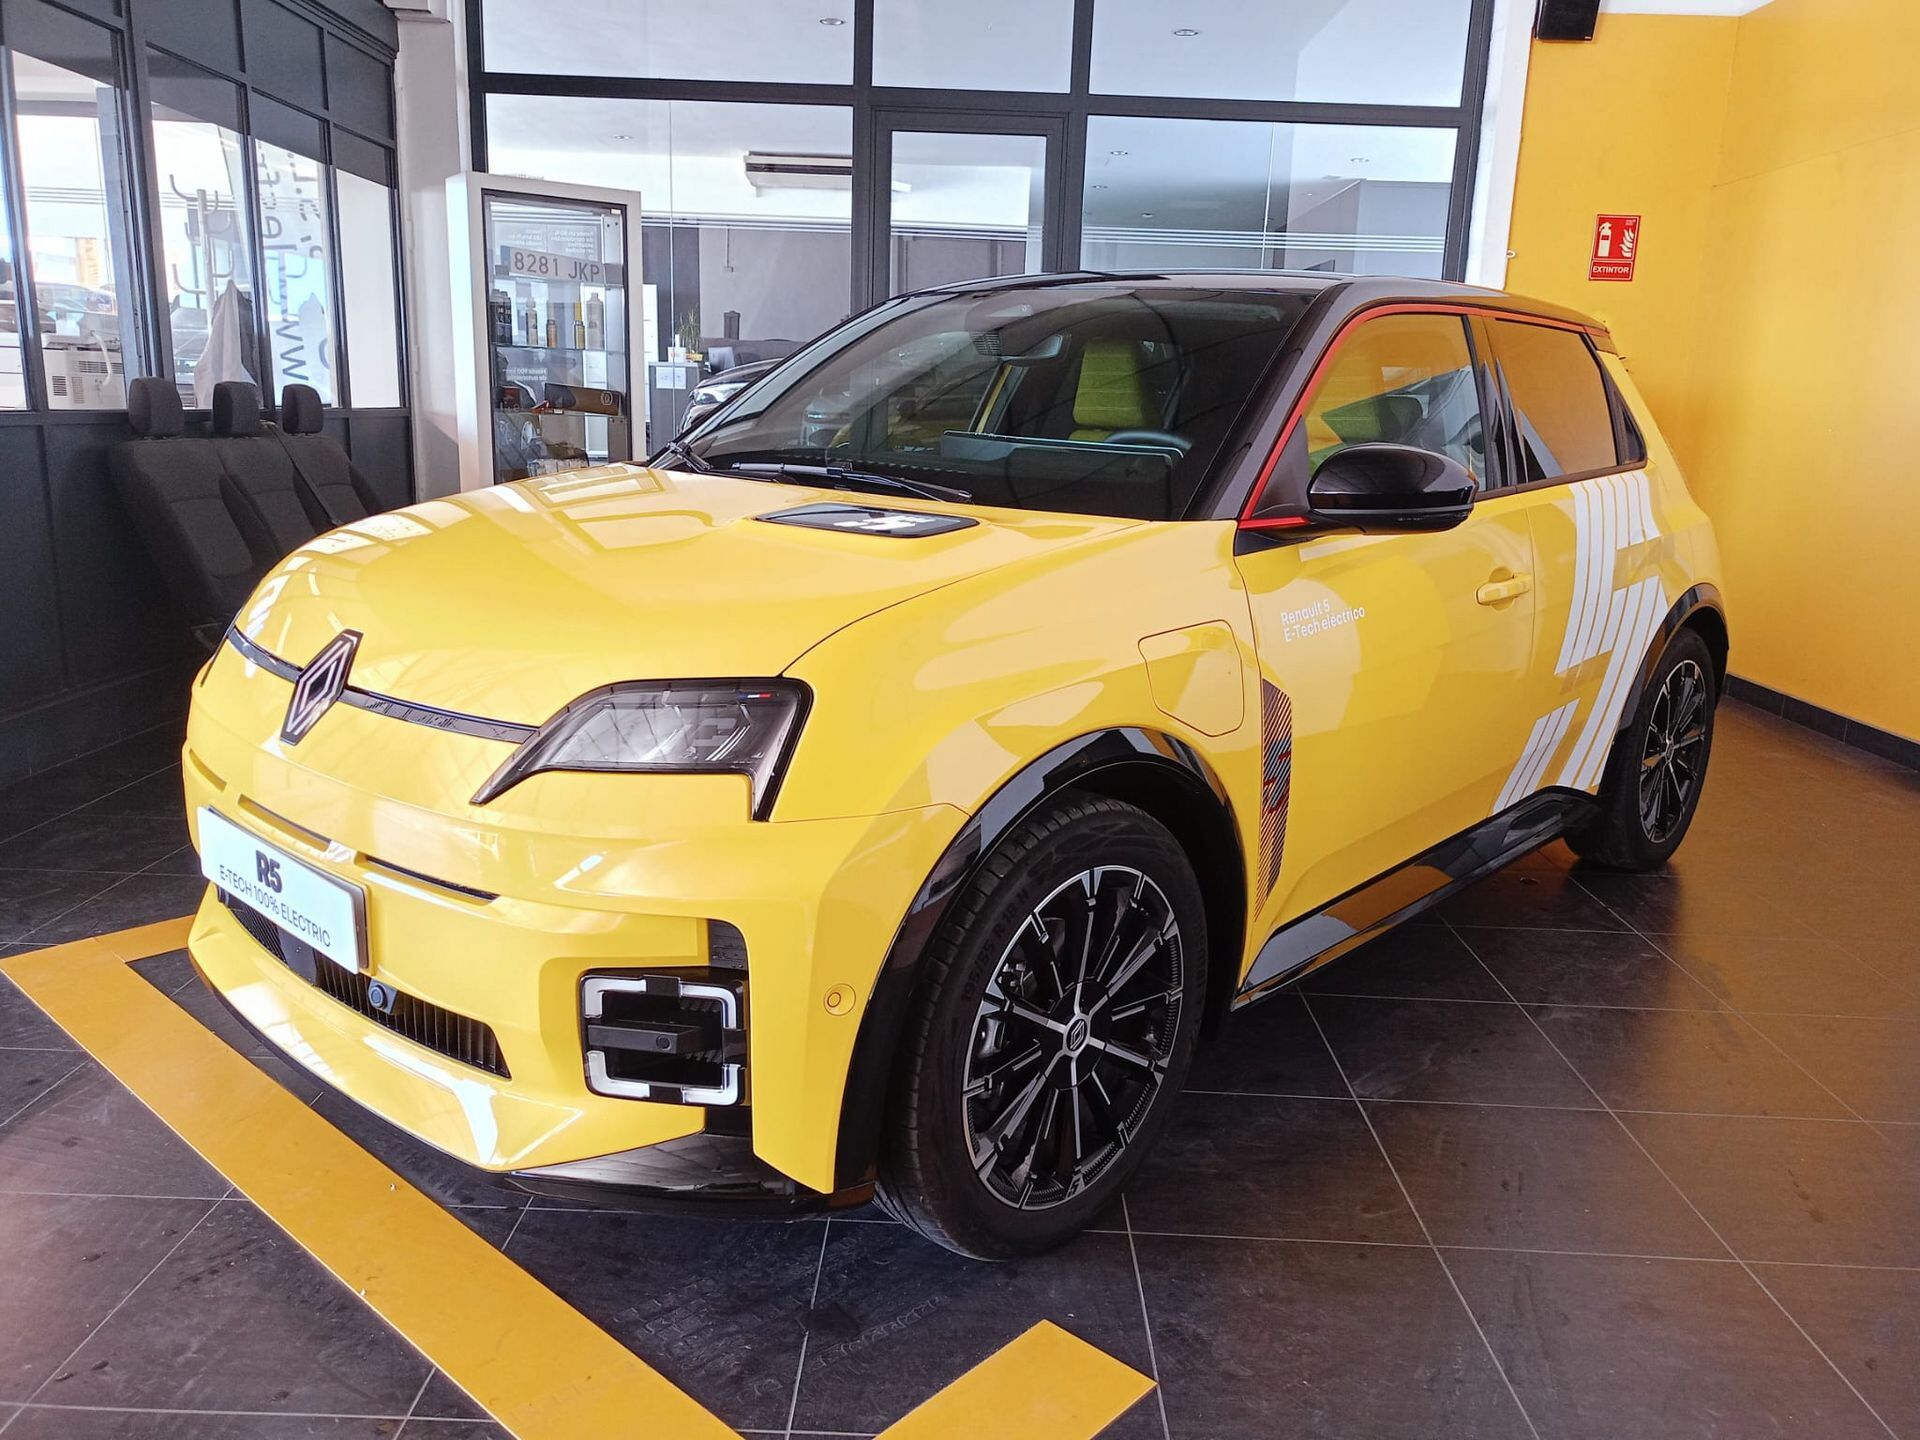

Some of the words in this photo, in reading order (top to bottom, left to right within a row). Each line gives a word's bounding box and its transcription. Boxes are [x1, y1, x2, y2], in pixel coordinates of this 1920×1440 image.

[514, 251, 558, 277] 8281
[568, 260, 600, 282] JKP
[1280, 600, 1323, 625] Renault
[1323, 599, 1330, 613] 5
[1283, 618, 1320, 642] E-Tech
[255, 850, 283, 893] R5
[219, 864, 253, 898] E-TECH
[253, 885, 280, 915] 100%
[280, 902, 331, 948] ELECTRIC
